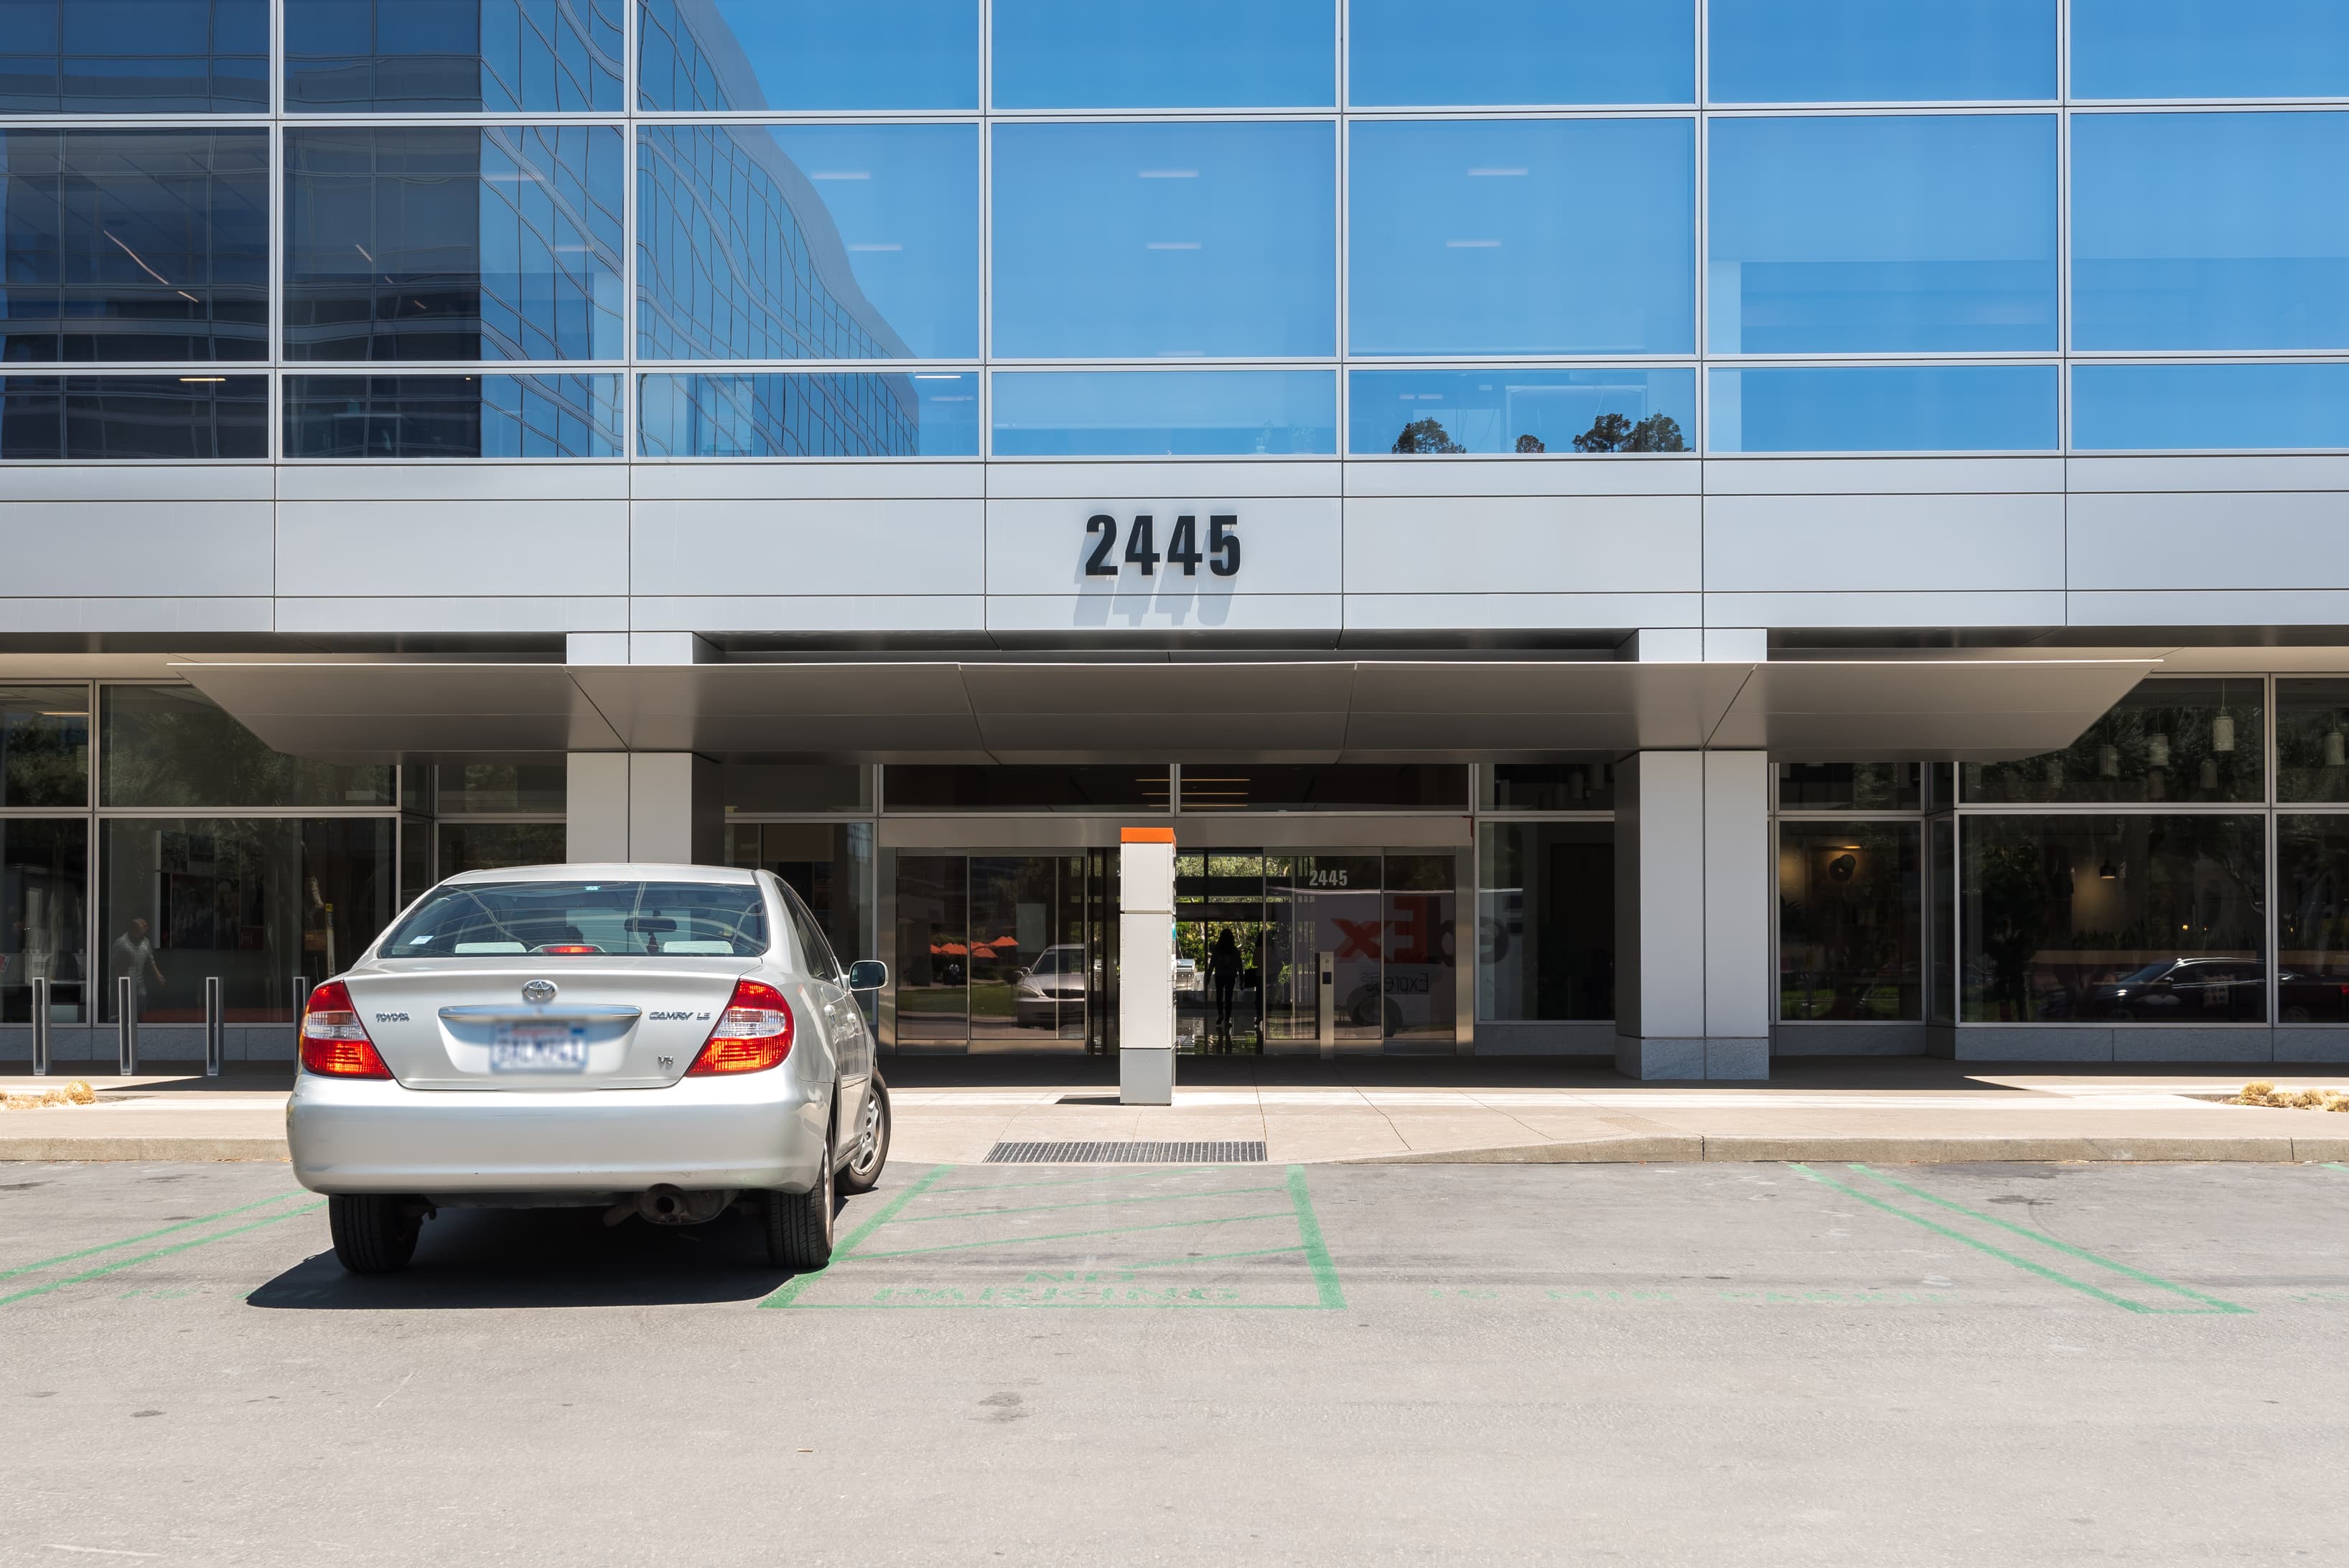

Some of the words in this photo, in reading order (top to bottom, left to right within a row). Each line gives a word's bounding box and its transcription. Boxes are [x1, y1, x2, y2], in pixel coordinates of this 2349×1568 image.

[1085, 514, 1241, 577] 2445
[1309, 869, 1348, 886] 2445
[376, 1012, 410, 1022] TOYOTA
[649, 1012, 694, 1020] CAMRY
[1023, 1270, 1136, 1284] NO
[872, 1287, 1241, 1301] PARKING
